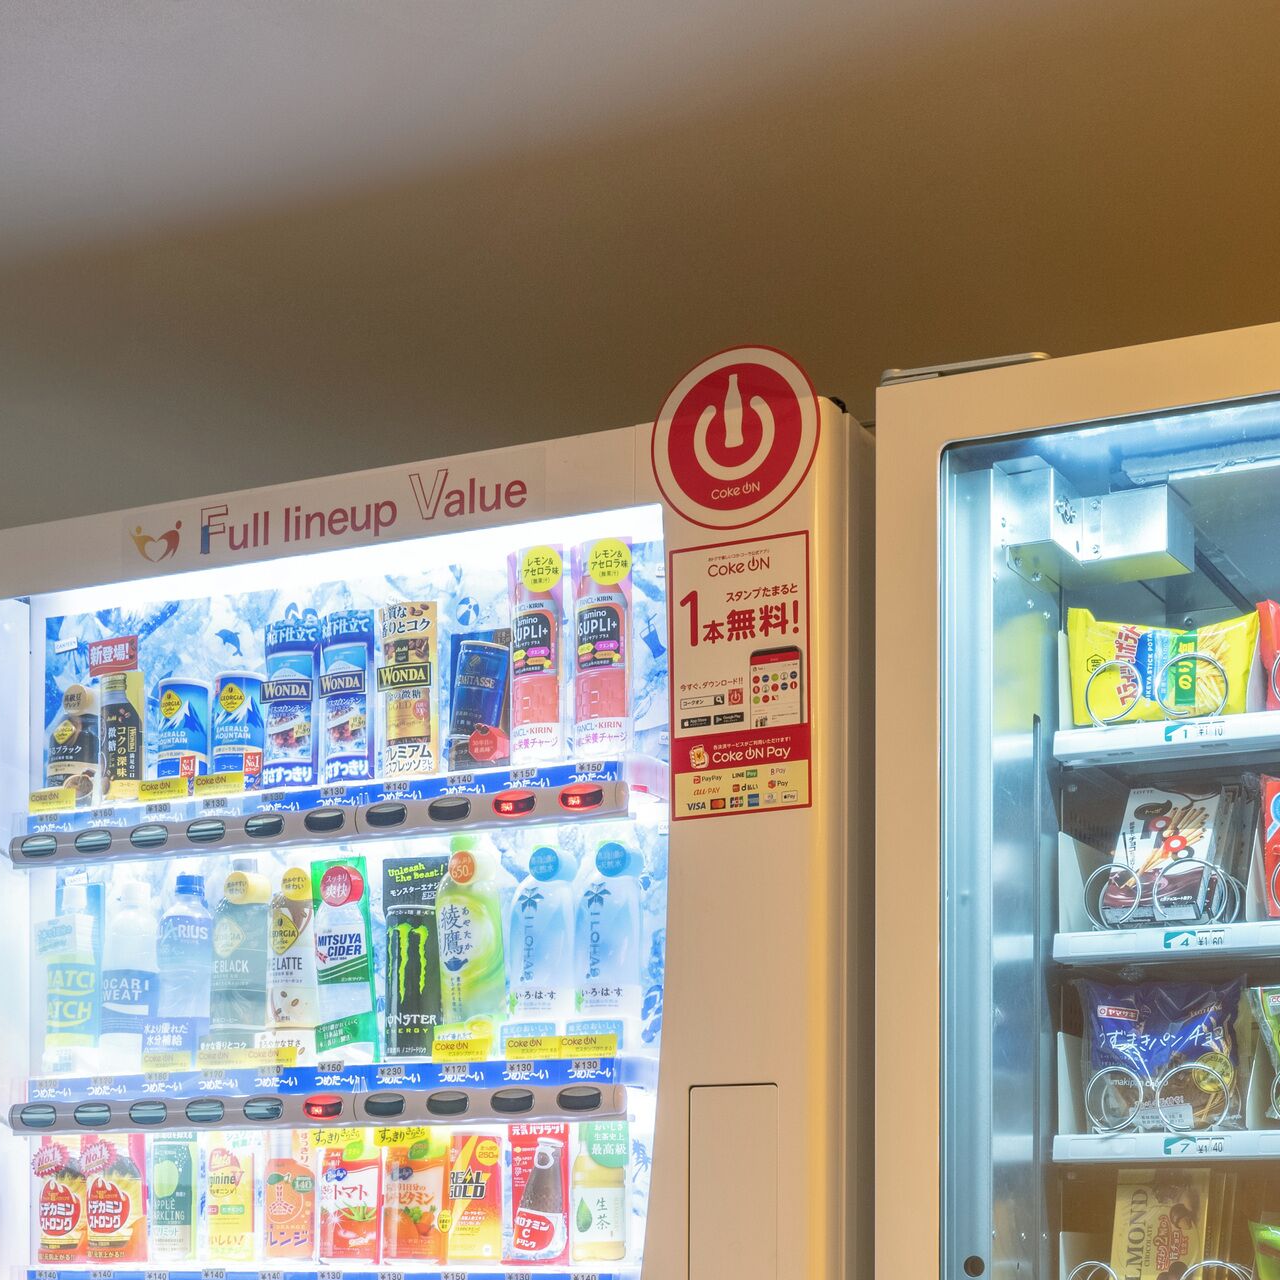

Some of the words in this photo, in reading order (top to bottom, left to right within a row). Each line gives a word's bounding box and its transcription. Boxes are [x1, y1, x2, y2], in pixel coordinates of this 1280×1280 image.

[711, 486, 740, 500] Coke
[742, 481, 761, 495] ON
[200, 504, 270, 556] Full
[284, 498, 397, 543] lineup
[409, 469, 528, 520] Value
[594, 548, 623, 559] レモン&
[526, 557, 554, 567] レモン&
[591, 558, 629, 570] アセロラ味
[708, 562, 745, 577] Coke
[747, 557, 770, 572] ON
[523, 566, 559, 577] アセロラ味
[726, 583, 798, 602] スタンプたまると
[596, 595, 613, 603] KIRIN
[528, 602, 545, 610] KIRIN
[584, 609, 607, 620] amino
[89, 644, 129, 666] 新登場!
[381, 667, 426, 684] WONDA
[322, 675, 361, 692] WONDA
[263, 684, 308, 700] WONDA
[530, 726, 554, 735] KIRIN
[601, 720, 623, 730] KIRIN
[117, 727, 127, 778] コクの深味
[712, 751, 743, 764] Coke
[745, 749, 764, 761] ON
[767, 746, 791, 762] Pay
[579, 762, 602, 772] ¥150
[512, 768, 536, 778] ¥150
[450, 775, 472, 784] ¥140
[701, 775, 723, 783] PayPay
[323, 787, 345, 796] ¥130
[386, 782, 408, 791] ¥140
[687, 802, 706, 811] VISA
[387, 862, 425, 877] Unleash
[395, 874, 411, 883] the
[412, 865, 444, 881] Beast!
[325, 885, 347, 899] 爽快
[442, 903, 463, 957] 綾鷹
[462, 904, 473, 952] あやたか
[318, 933, 362, 947] MITSUYA
[1180, 937, 1190, 947] 4
[327, 945, 362, 958] CIDER
[1107, 1007, 1139, 1021] ヤマザキ
[434, 1042, 455, 1052] Coke
[455, 1041, 469, 1050] ON
[507, 1040, 528, 1049] Coke
[529, 1038, 543, 1047] ON
[561, 1037, 582, 1047] Coke
[583, 1036, 597, 1045] ON
[320, 1063, 342, 1072] ¥150
[379, 1067, 402, 1075] ¥230
[445, 1065, 467, 1073] ¥170
[509, 1063, 532, 1072] ¥130
[574, 1061, 598, 1070] ¥130
[313, 1129, 340, 1145] すっきり
[378, 1128, 405, 1143] すっきり
[592, 1143, 627, 1155] 最高級
[1180, 1143, 1189, 1153] 7
[333, 1182, 368, 1200] トマト
[595, 1197, 611, 1231] 生茶
[521, 1228, 531, 1239] C
[37, 1271, 57, 1279] ¥140
[92, 1270, 112, 1279] ¥140
[147, 1272, 167, 1280] ¥140
[204, 1270, 225, 1279] ¥140
[261, 1272, 281, 1280] ¥140
[320, 1272, 342, 1280] ¥130
[443, 1272, 466, 1280] ¥150
